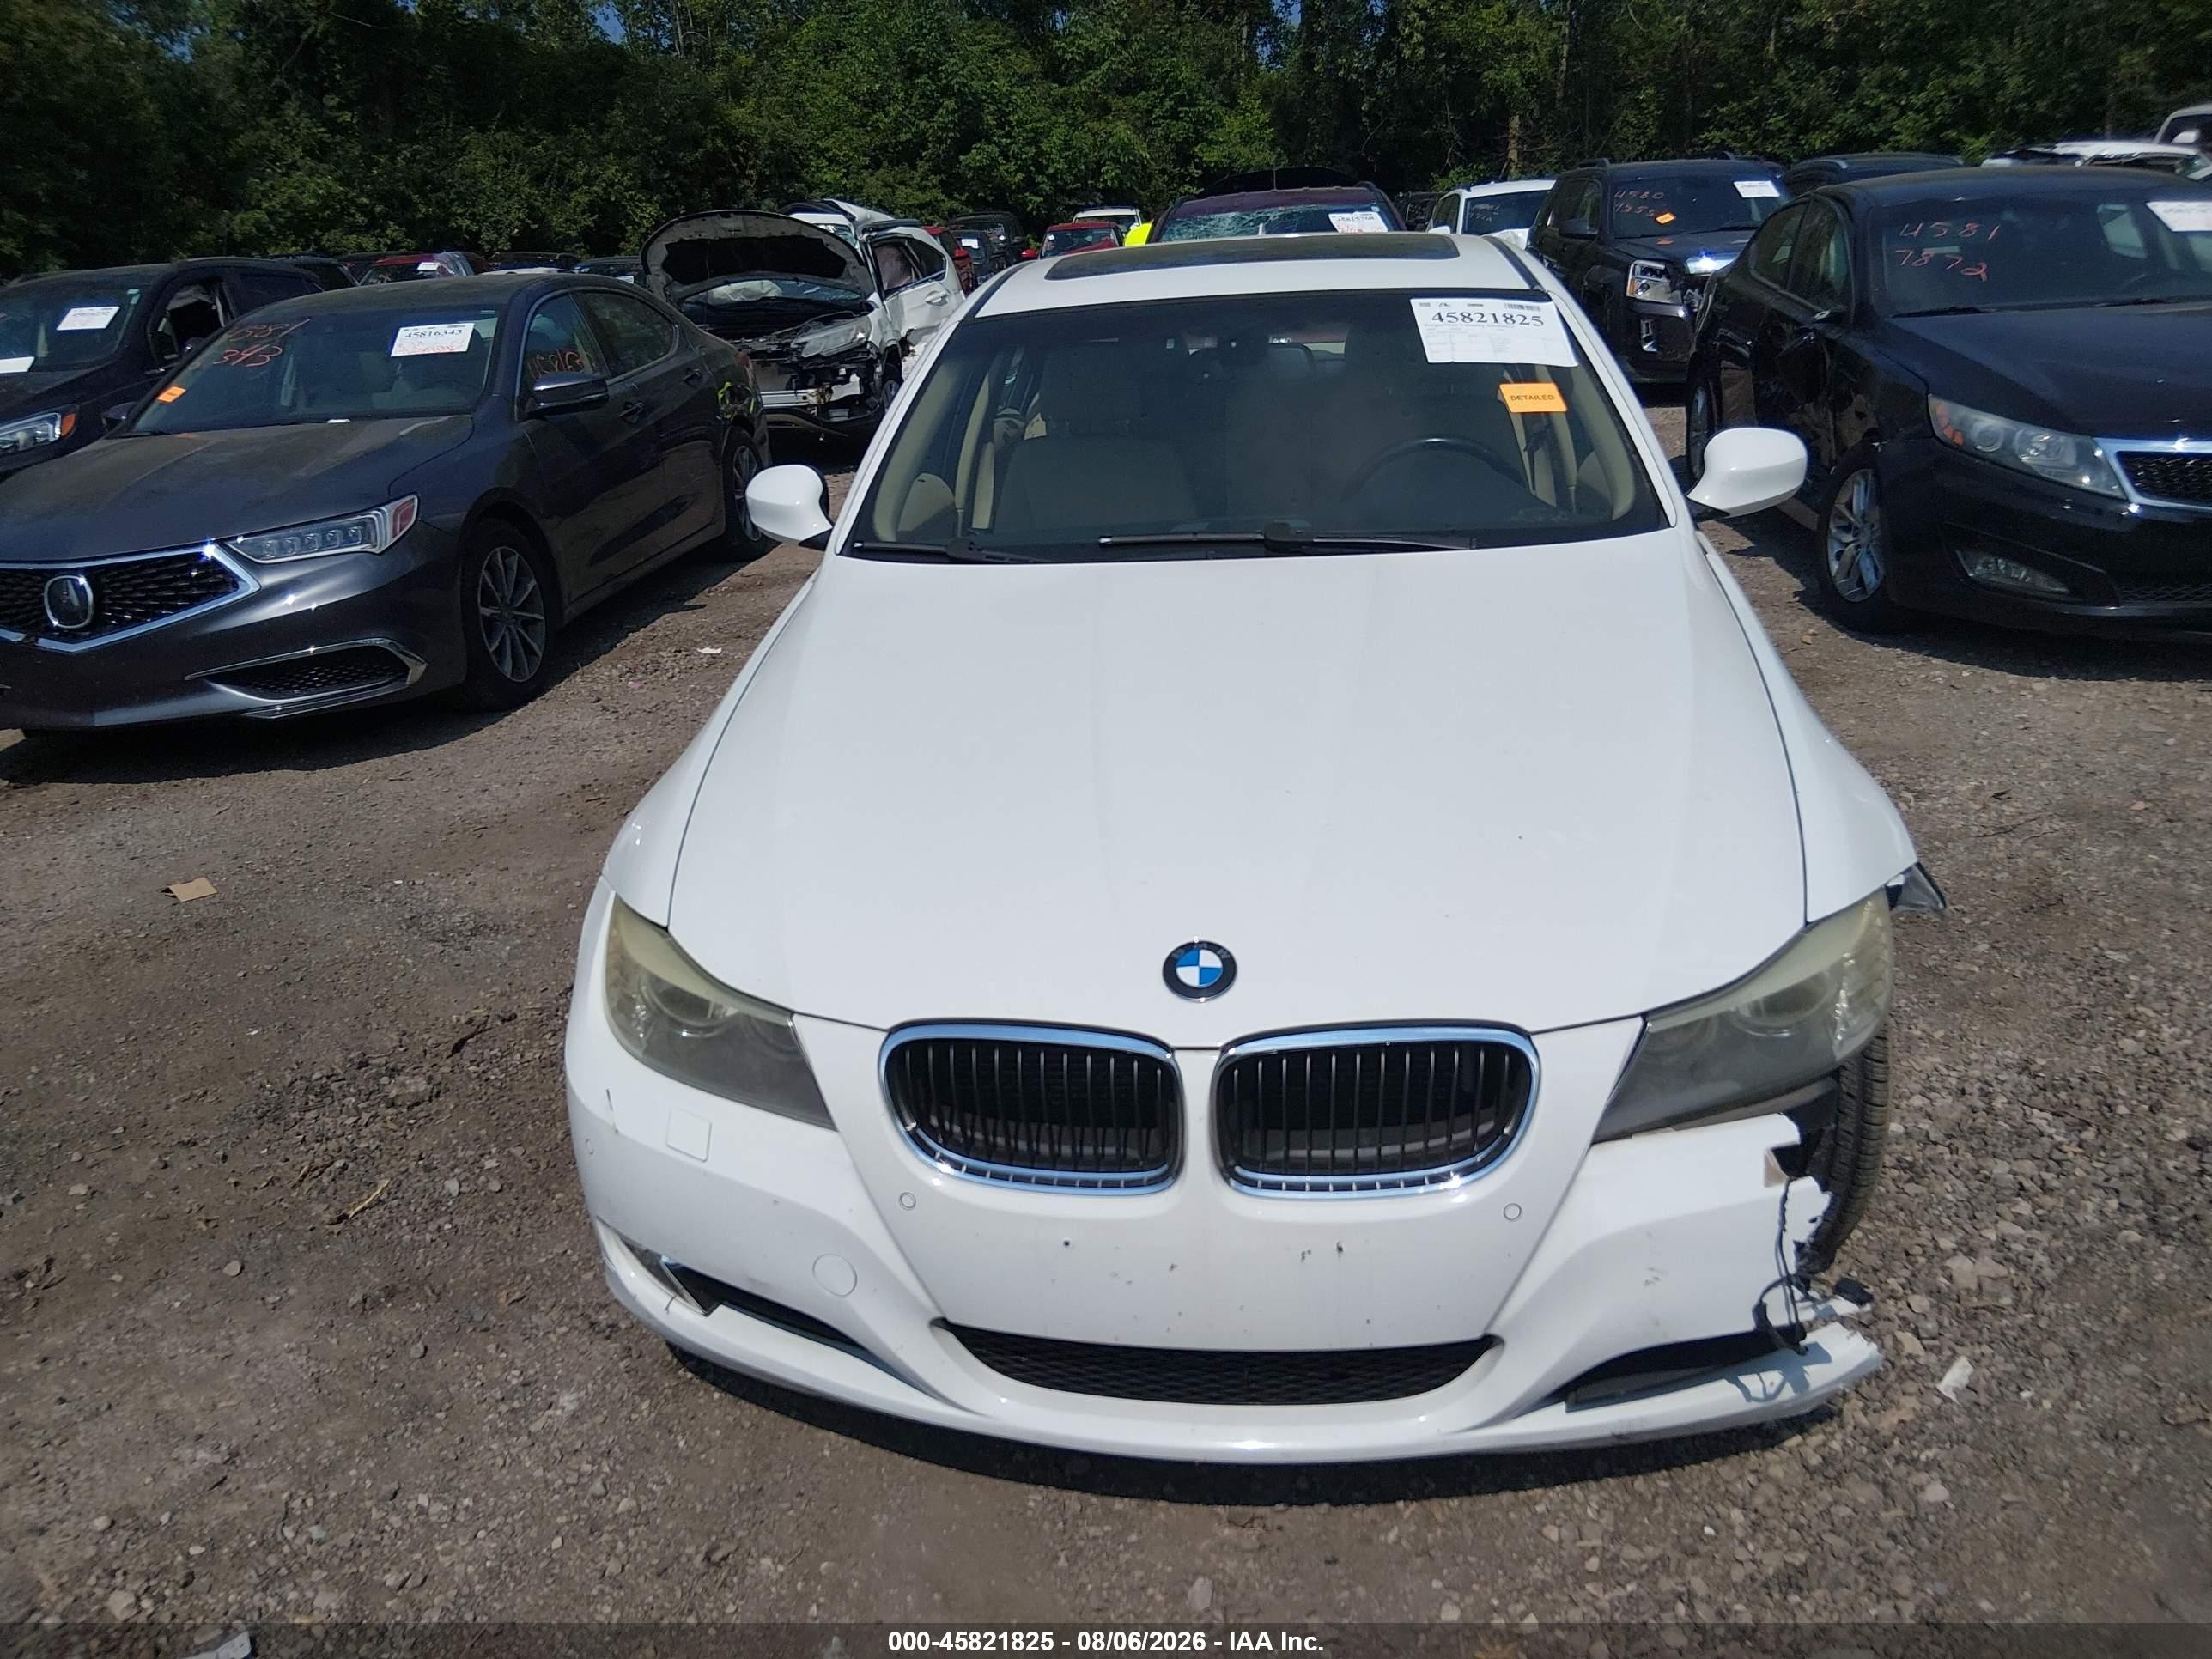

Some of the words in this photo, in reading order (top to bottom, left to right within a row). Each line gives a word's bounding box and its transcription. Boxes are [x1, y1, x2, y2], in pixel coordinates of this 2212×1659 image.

[1899, 222, 2000, 240] 4581
[1431, 311, 1545, 327] 45821825
[405, 329, 462, 338] 45816343
